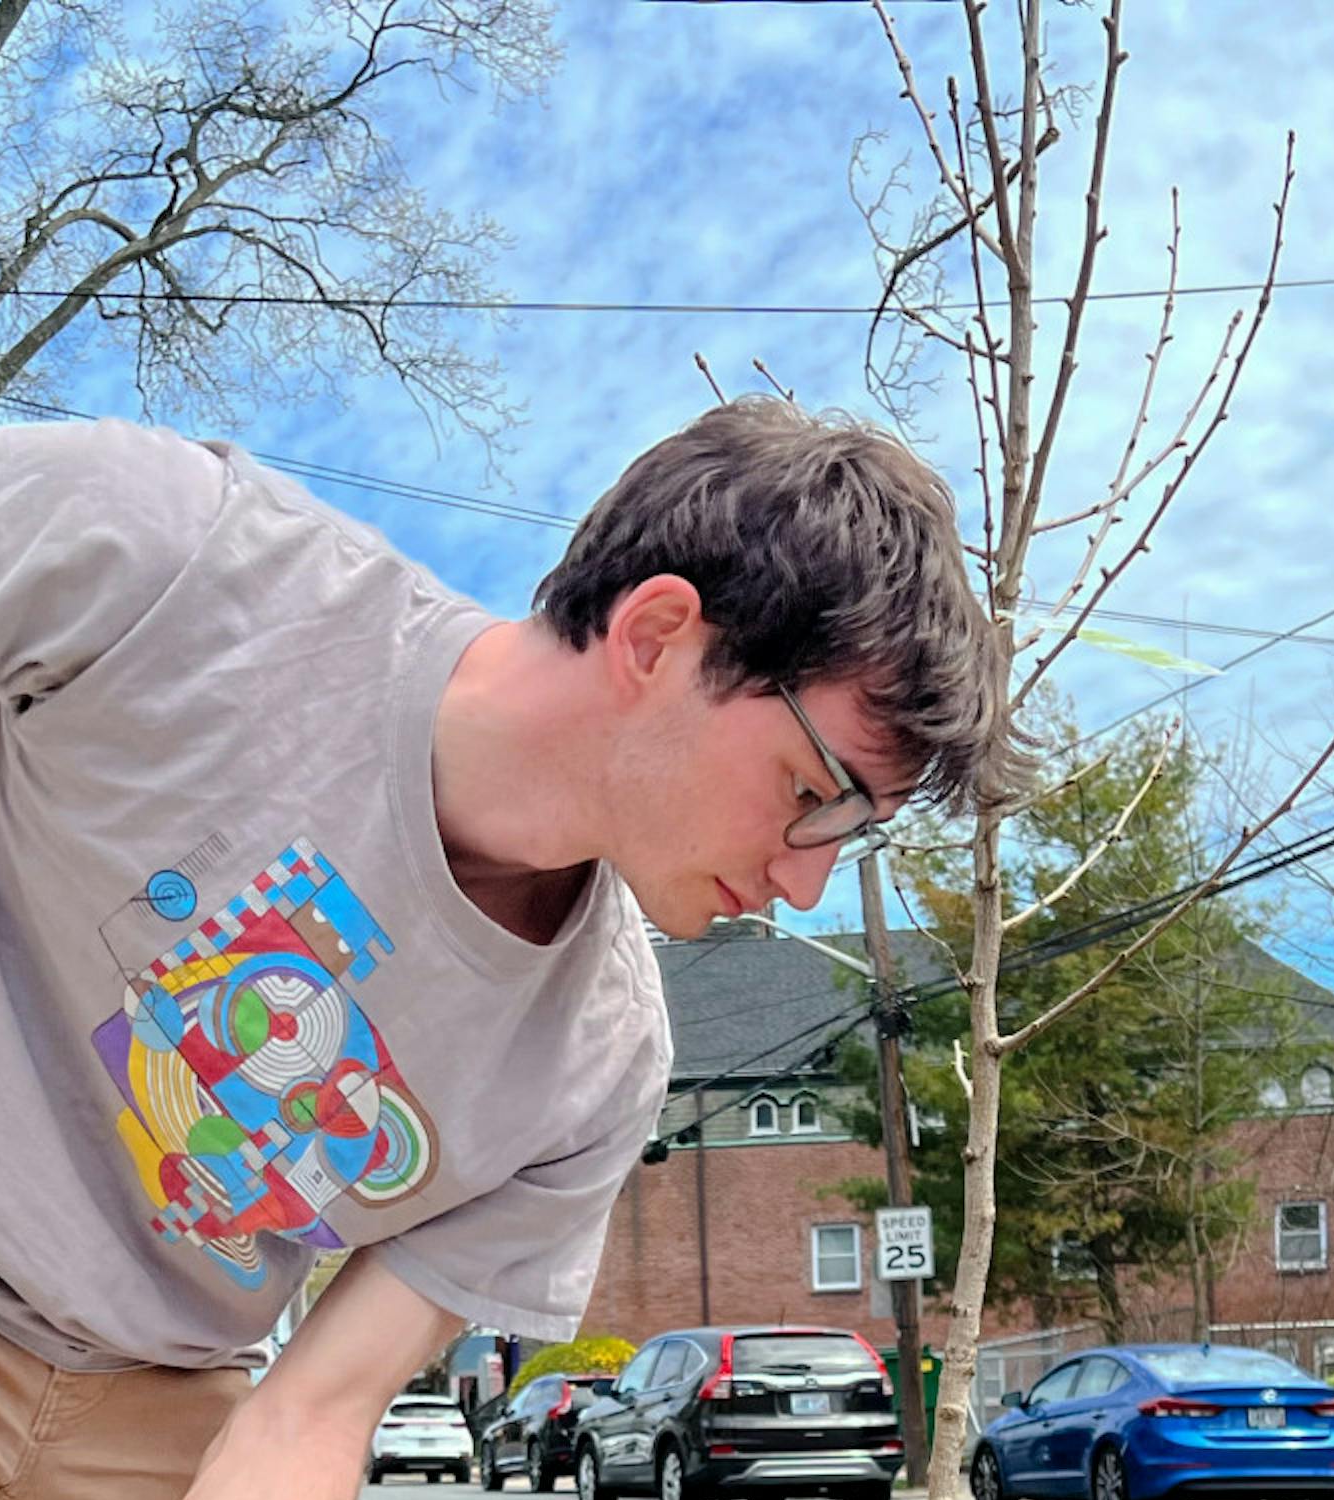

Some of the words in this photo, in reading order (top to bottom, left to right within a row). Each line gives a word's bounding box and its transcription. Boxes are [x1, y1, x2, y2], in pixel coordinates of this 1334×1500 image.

[882, 1216, 926, 1229] SPEED
[886, 1230, 922, 1243] LIMIT
[886, 1245, 926, 1270] 25
